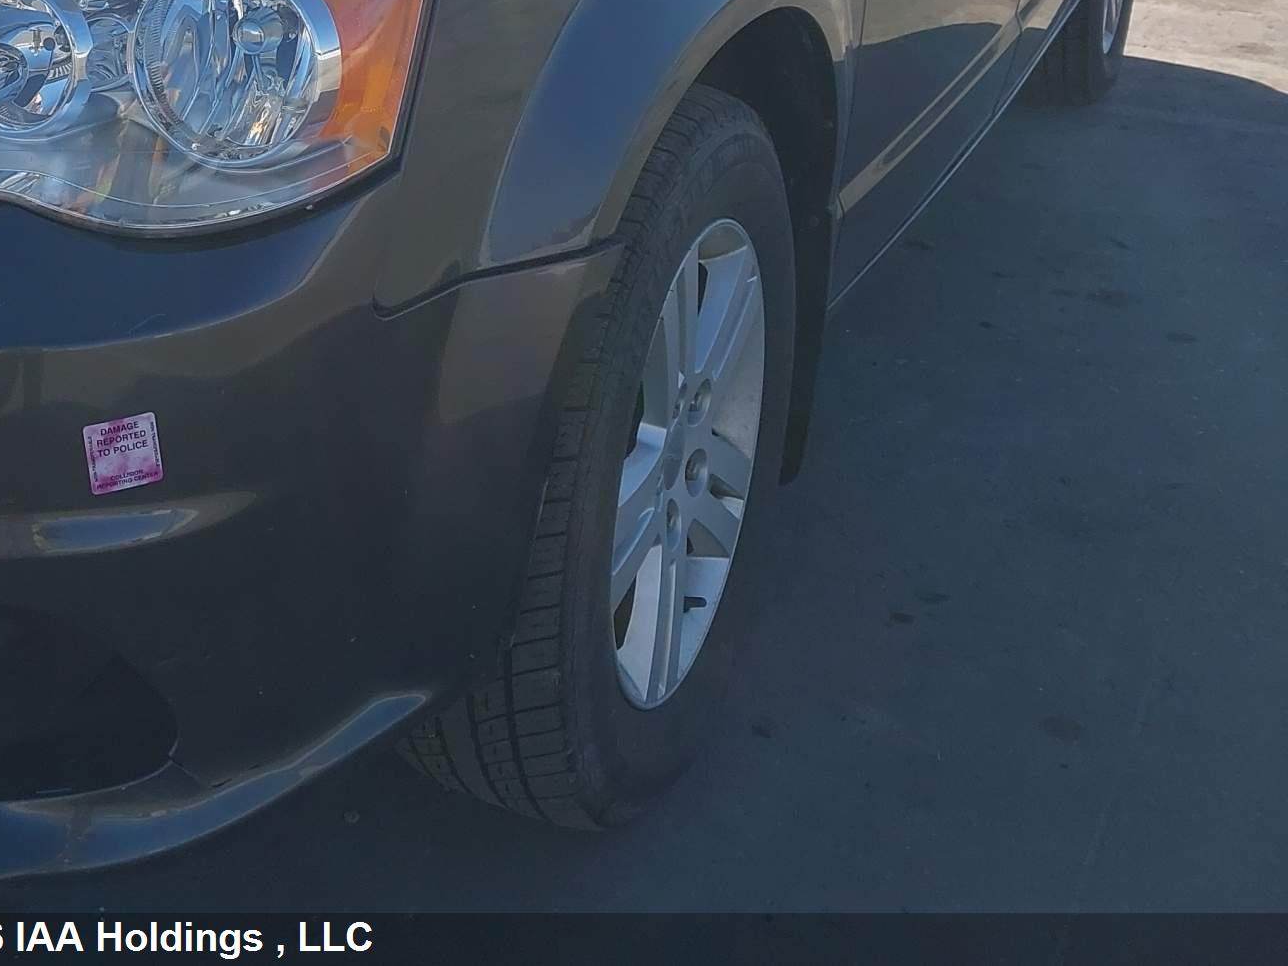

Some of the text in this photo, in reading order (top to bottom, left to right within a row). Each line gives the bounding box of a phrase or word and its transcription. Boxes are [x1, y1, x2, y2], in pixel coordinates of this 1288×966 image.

[100, 421, 140, 436] DAMAGE
[96, 430, 146, 448] REPORTED
[97, 439, 149, 458] TO POLICE
